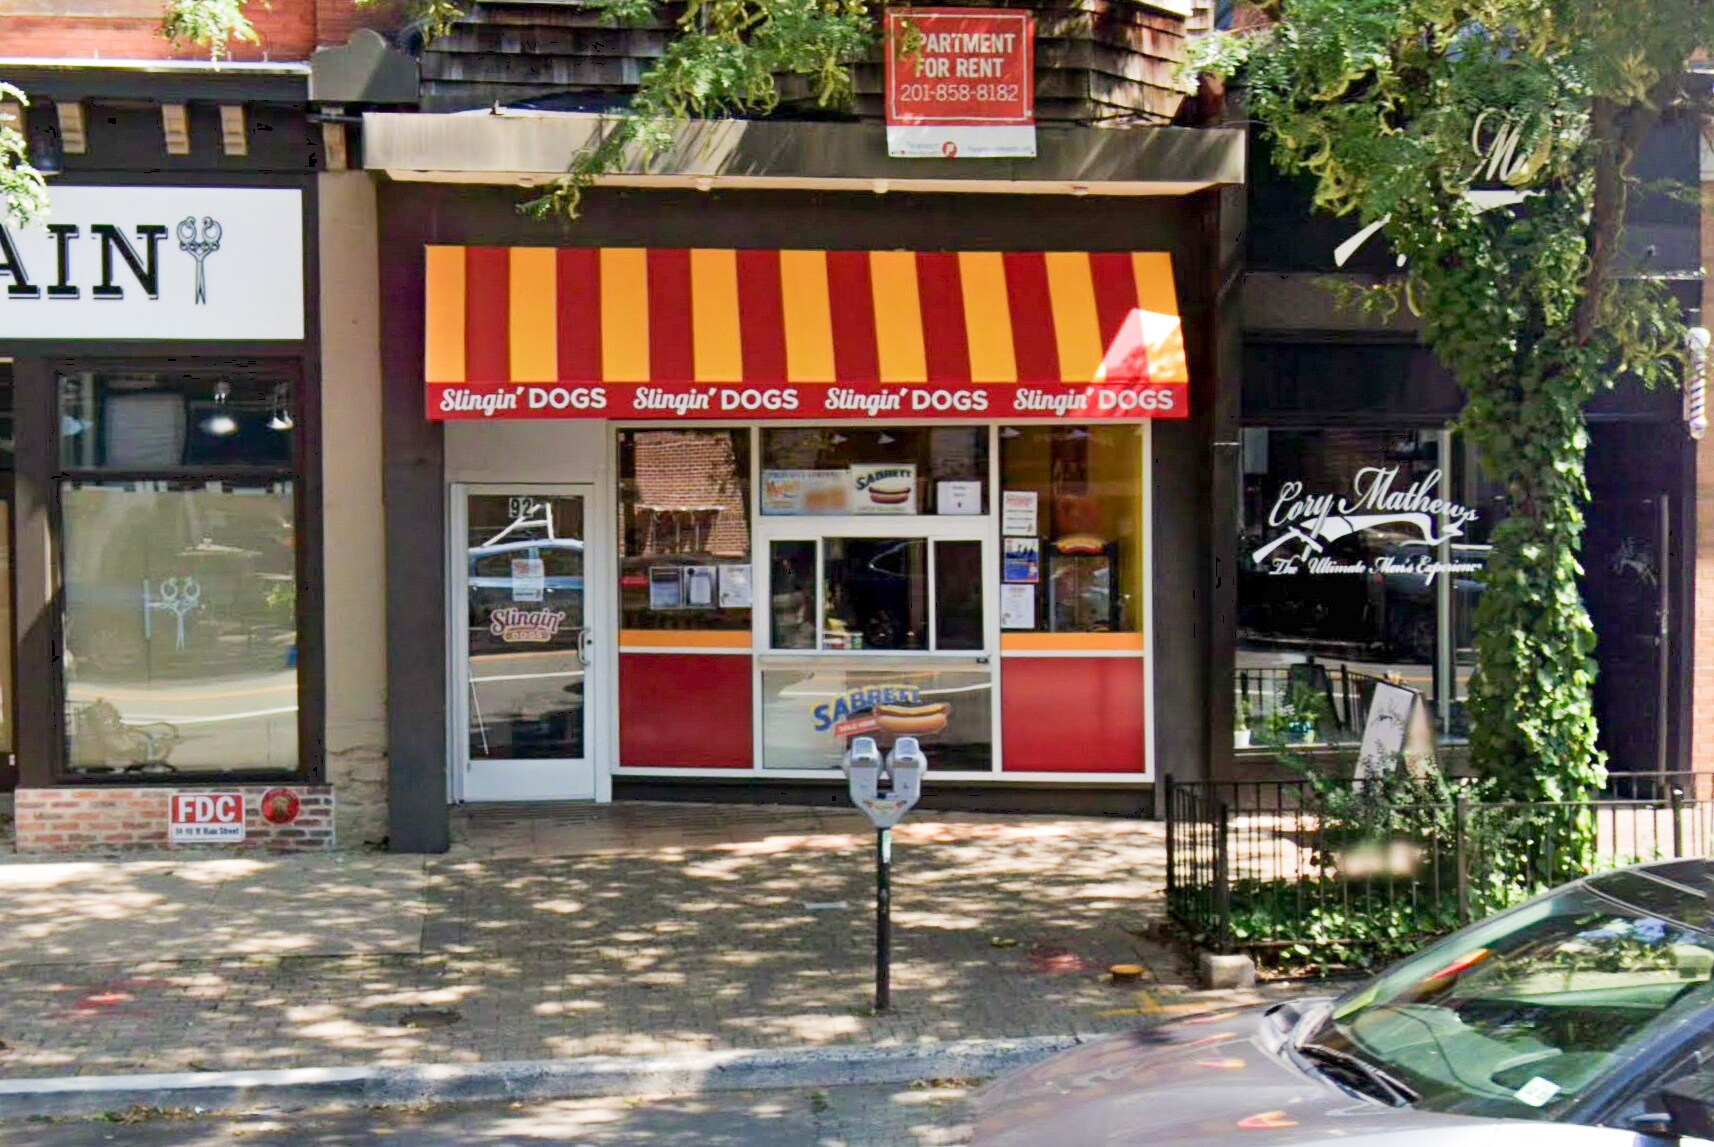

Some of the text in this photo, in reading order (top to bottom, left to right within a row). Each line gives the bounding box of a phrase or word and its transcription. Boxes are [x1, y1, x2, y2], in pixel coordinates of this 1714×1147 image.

[904, 32, 1015, 54] PARTMENT
[914, 58, 1005, 78] FOR RENT
[899, 84, 1019, 102] 201-858-8182
[527, 387, 607, 411] DOGS
[719, 388, 799, 411] DOGS
[910, 388, 988, 412] DOGS
[1097, 388, 1173, 411] DOGS
[1268, 465, 1478, 530] Cory Mathews
[1269, 556, 1298, 575] The
[1307, 556, 1366, 574] Ultimate
[812, 686, 921, 731] SABRETT
[178, 796, 236, 823] FDC
[219, 827, 239, 836] Street
